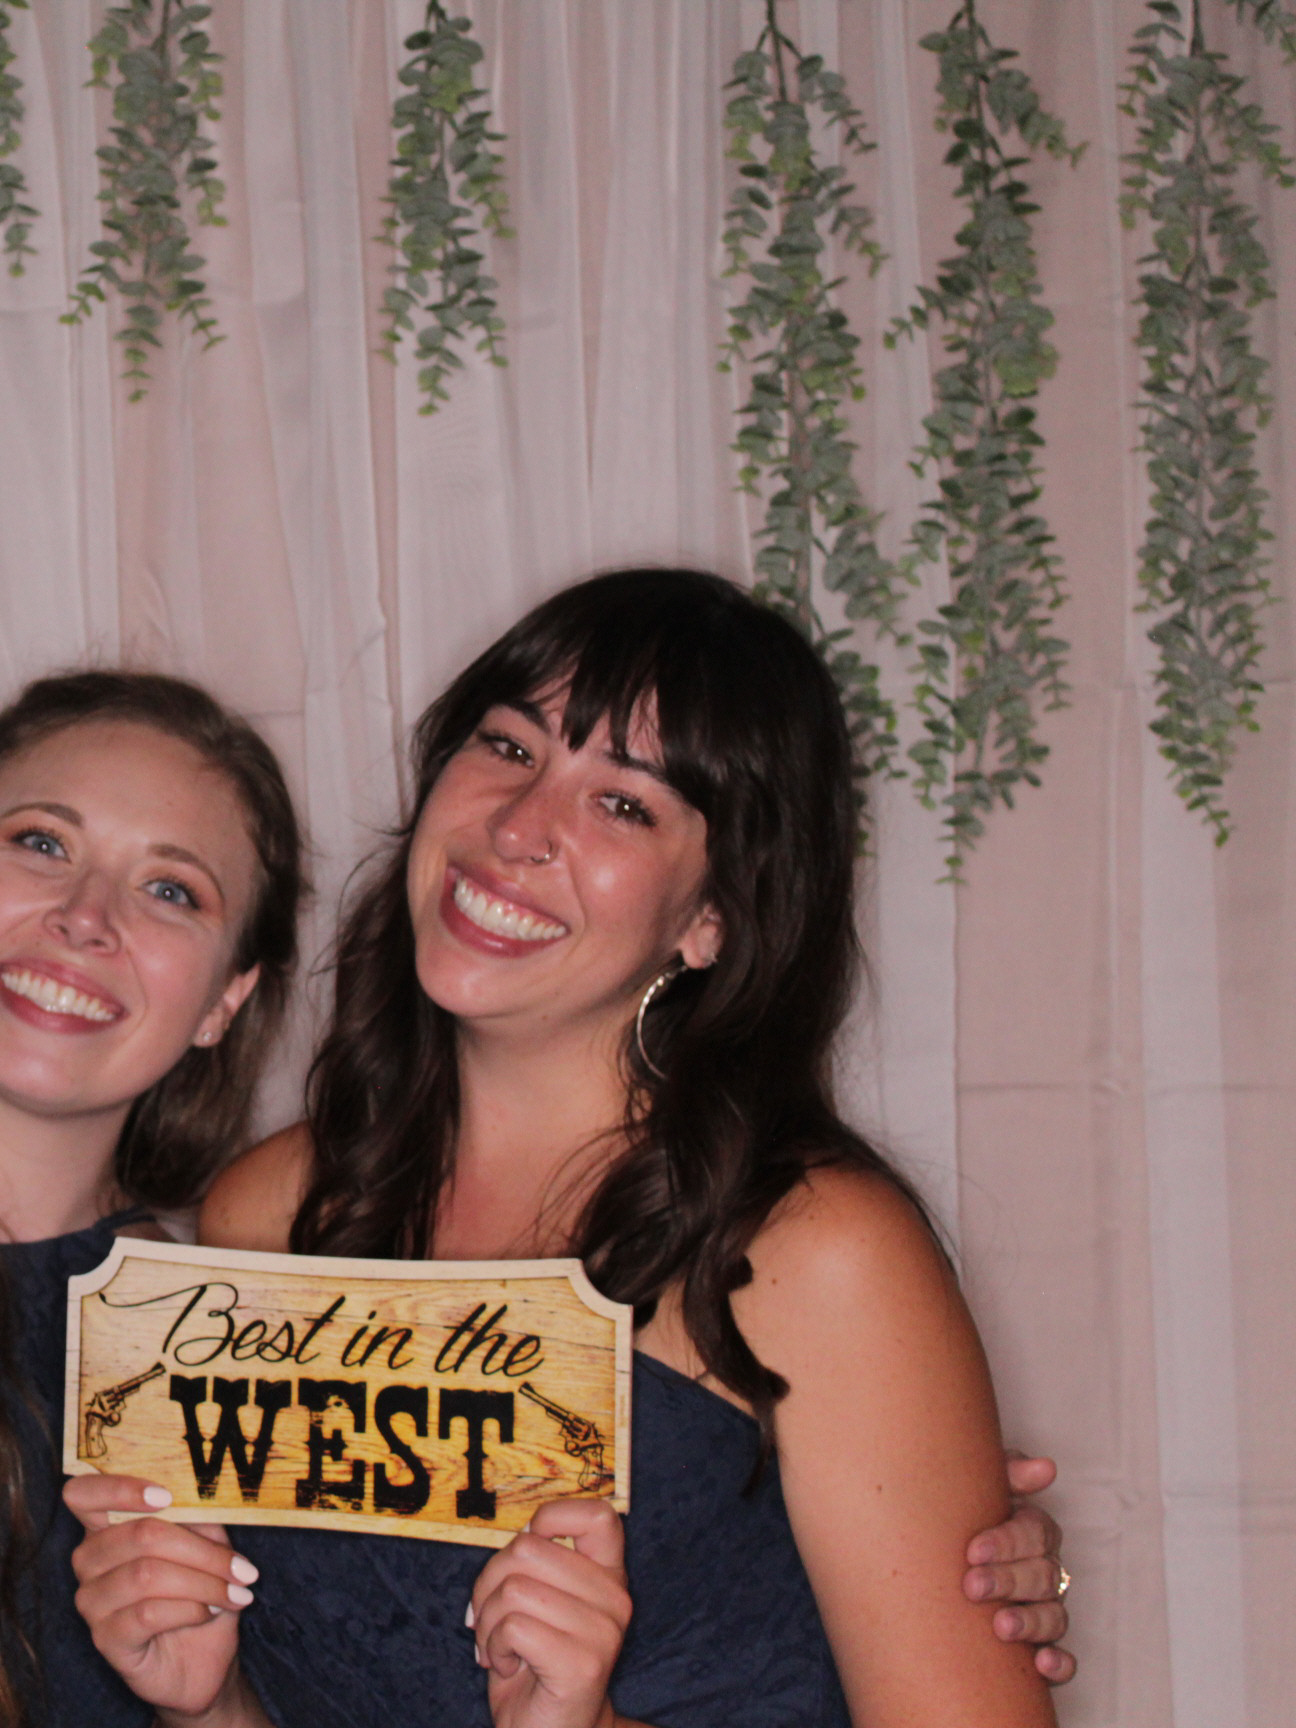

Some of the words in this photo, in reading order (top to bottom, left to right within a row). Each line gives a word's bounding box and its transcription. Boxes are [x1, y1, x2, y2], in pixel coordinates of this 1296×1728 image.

[99, 1281, 346, 1366] Best
[340, 1310, 415, 1369] in
[433, 1302, 544, 1378] the
[169, 1373, 515, 1521] WEST
